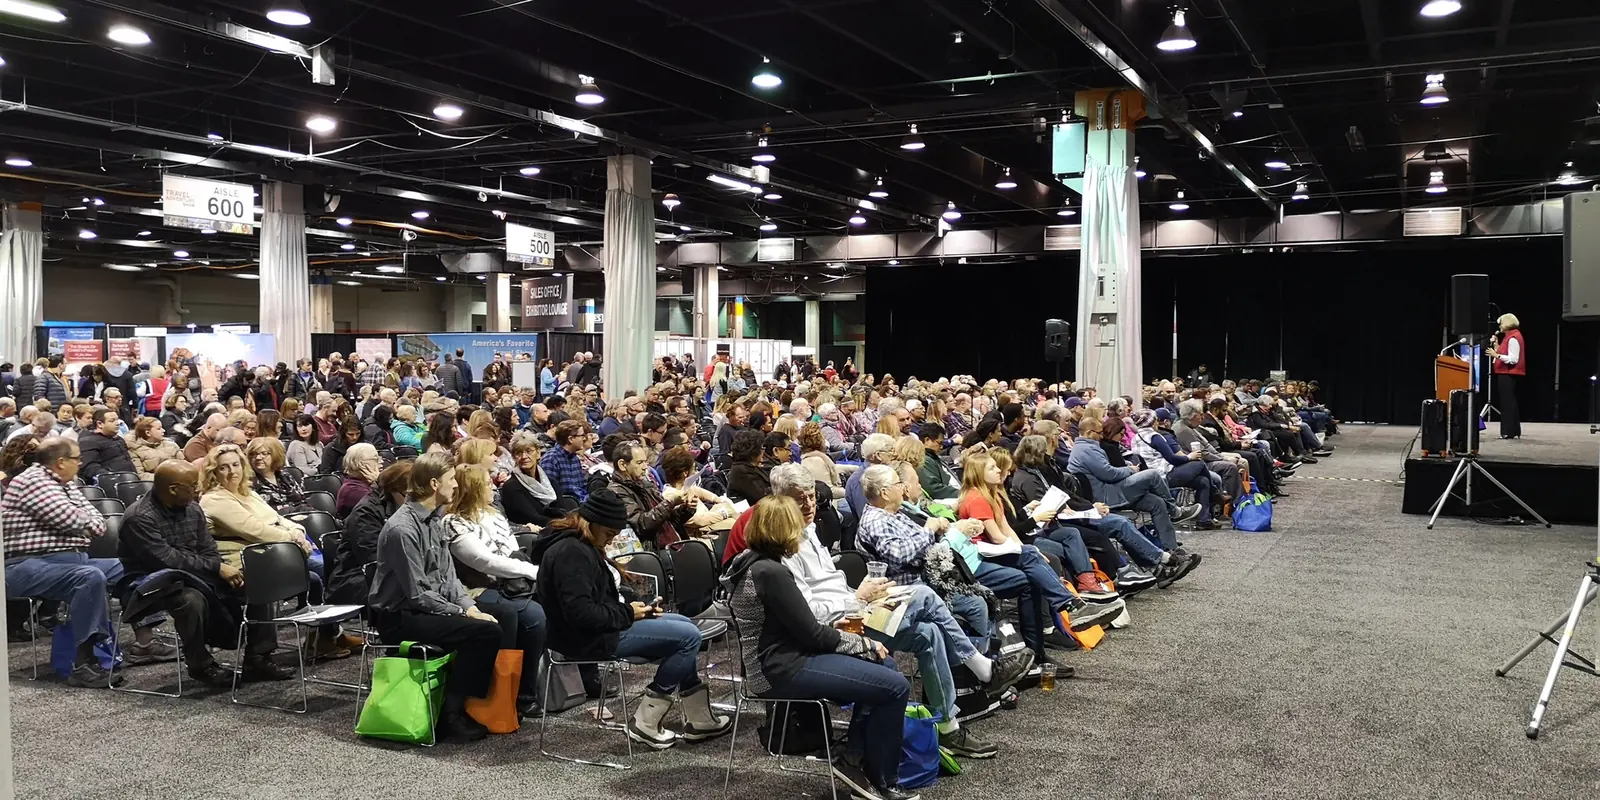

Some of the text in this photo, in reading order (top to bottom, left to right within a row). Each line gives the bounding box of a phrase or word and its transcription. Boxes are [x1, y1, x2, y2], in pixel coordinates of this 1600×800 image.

[166, 189, 190, 198] TRAVEL
[214, 187, 240, 198] AISLE
[208, 197, 244, 218] 600
[533, 231, 547, 240] AISLE
[530, 239, 550, 255] 500
[530, 287, 543, 299] SALES
[544, 285, 560, 298] OFFICE
[526, 302, 568, 317] EXHIBITOR LOUNGE
